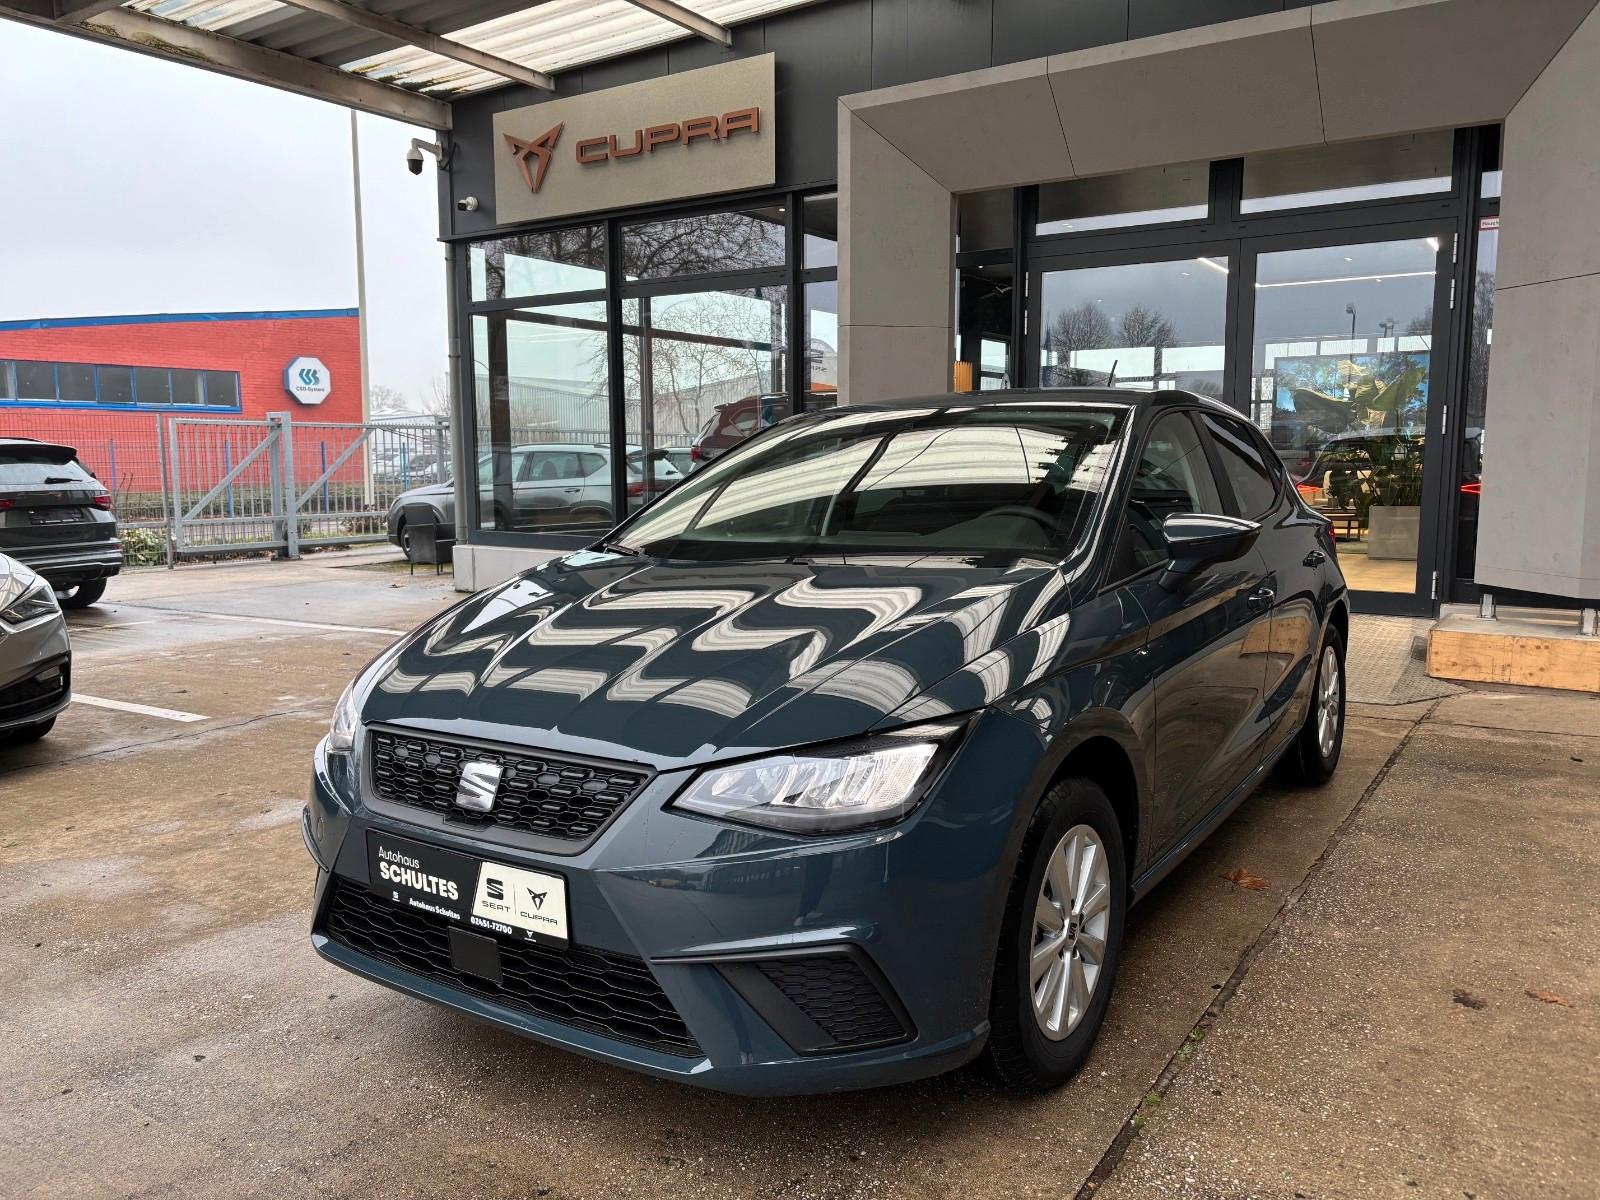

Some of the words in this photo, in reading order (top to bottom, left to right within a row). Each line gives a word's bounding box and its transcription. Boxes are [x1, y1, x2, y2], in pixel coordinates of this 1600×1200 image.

[575, 106, 760, 164] CUPRA
[379, 846, 420, 868] Autohaus
[380, 861, 459, 900] SCHULTES
[409, 897, 435, 913] Autohaus
[435, 906, 460, 919] Schultes
[481, 900, 511, 913] SEAT
[470, 916, 512, 934] 02451-72700
[520, 911, 558, 925] CUPRA
